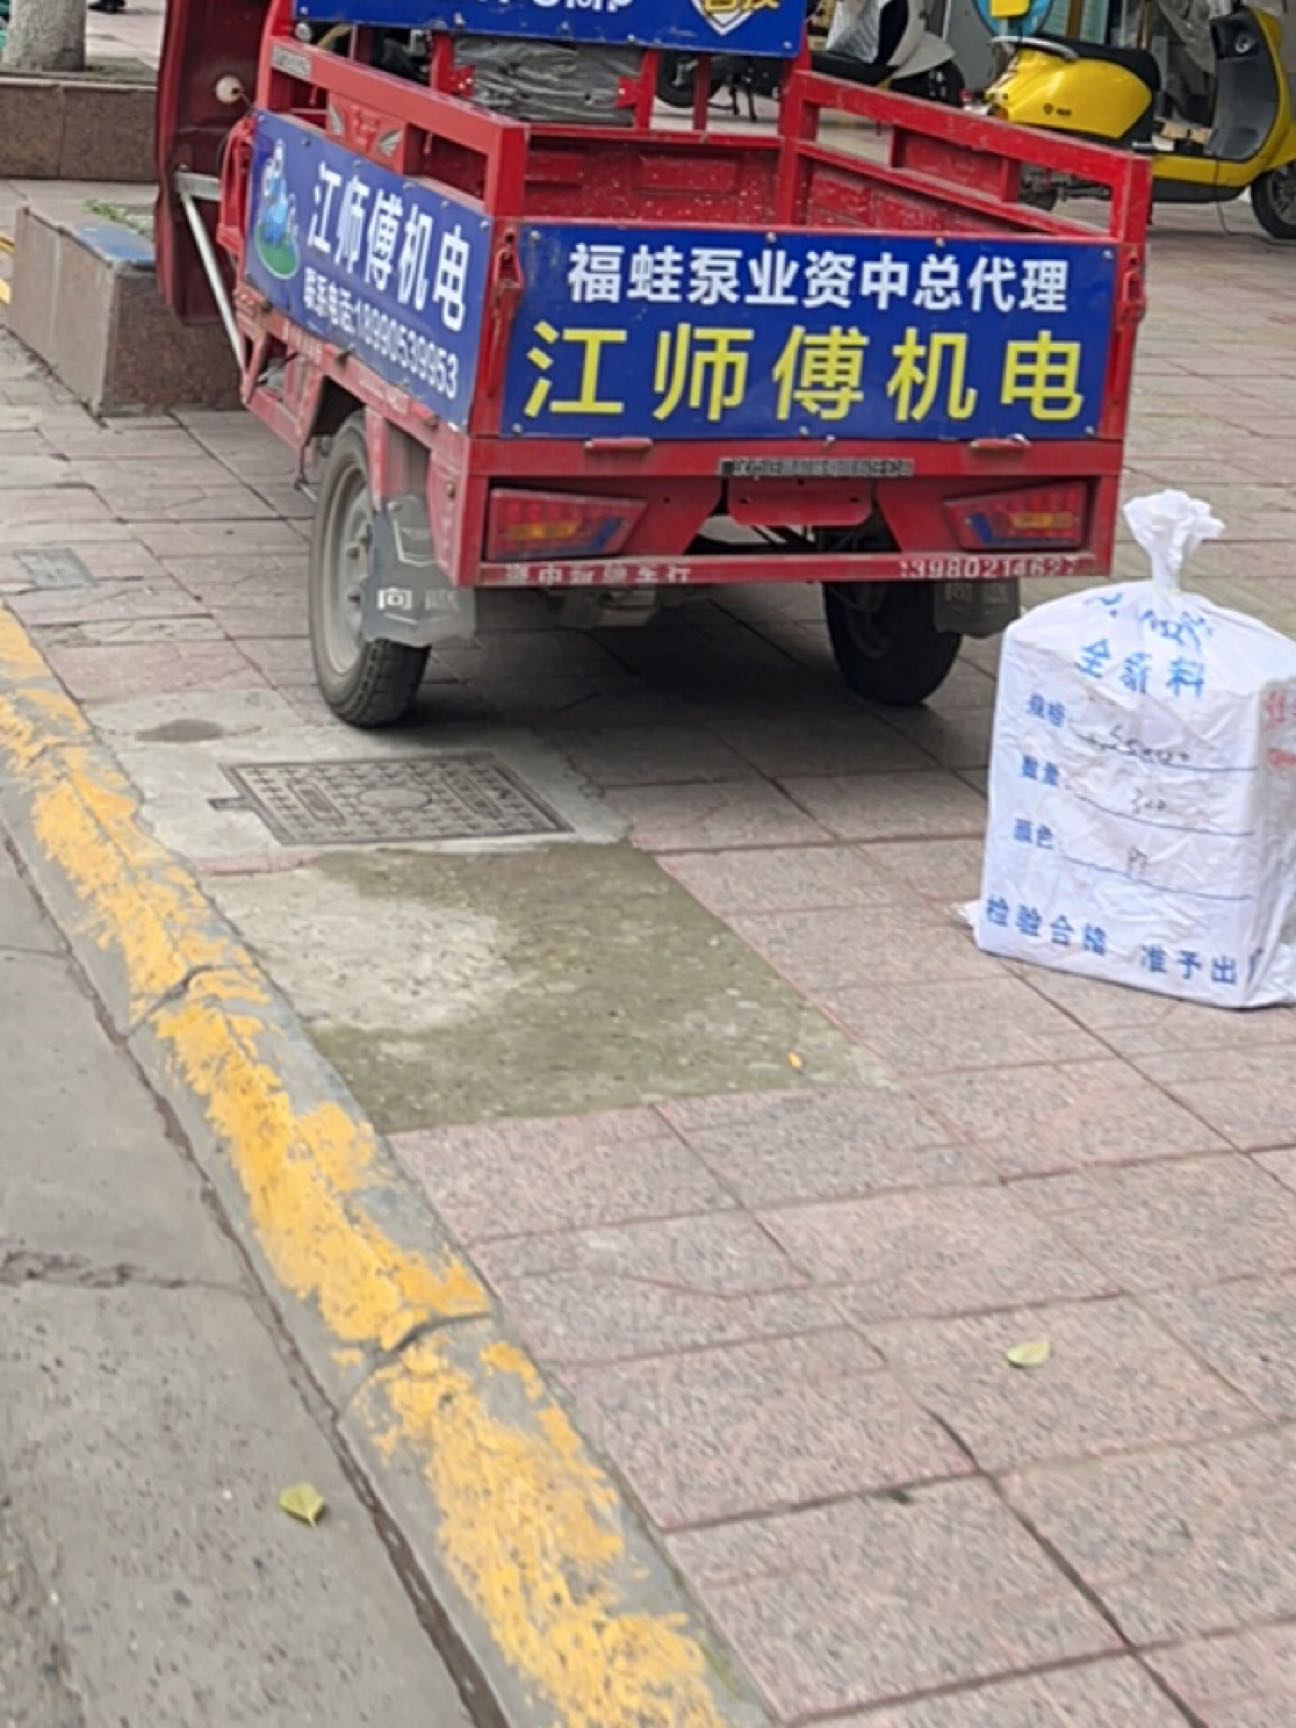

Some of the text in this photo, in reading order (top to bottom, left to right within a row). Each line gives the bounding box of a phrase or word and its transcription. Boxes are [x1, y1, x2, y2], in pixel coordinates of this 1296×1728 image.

[308, 160, 470, 332] 江师傅机电
[568, 243, 1071, 314] 福蛙泵业资中总代理
[524, 321, 1085, 423] 江师傅机电
[985, 892, 1108, 958] 检验合格
